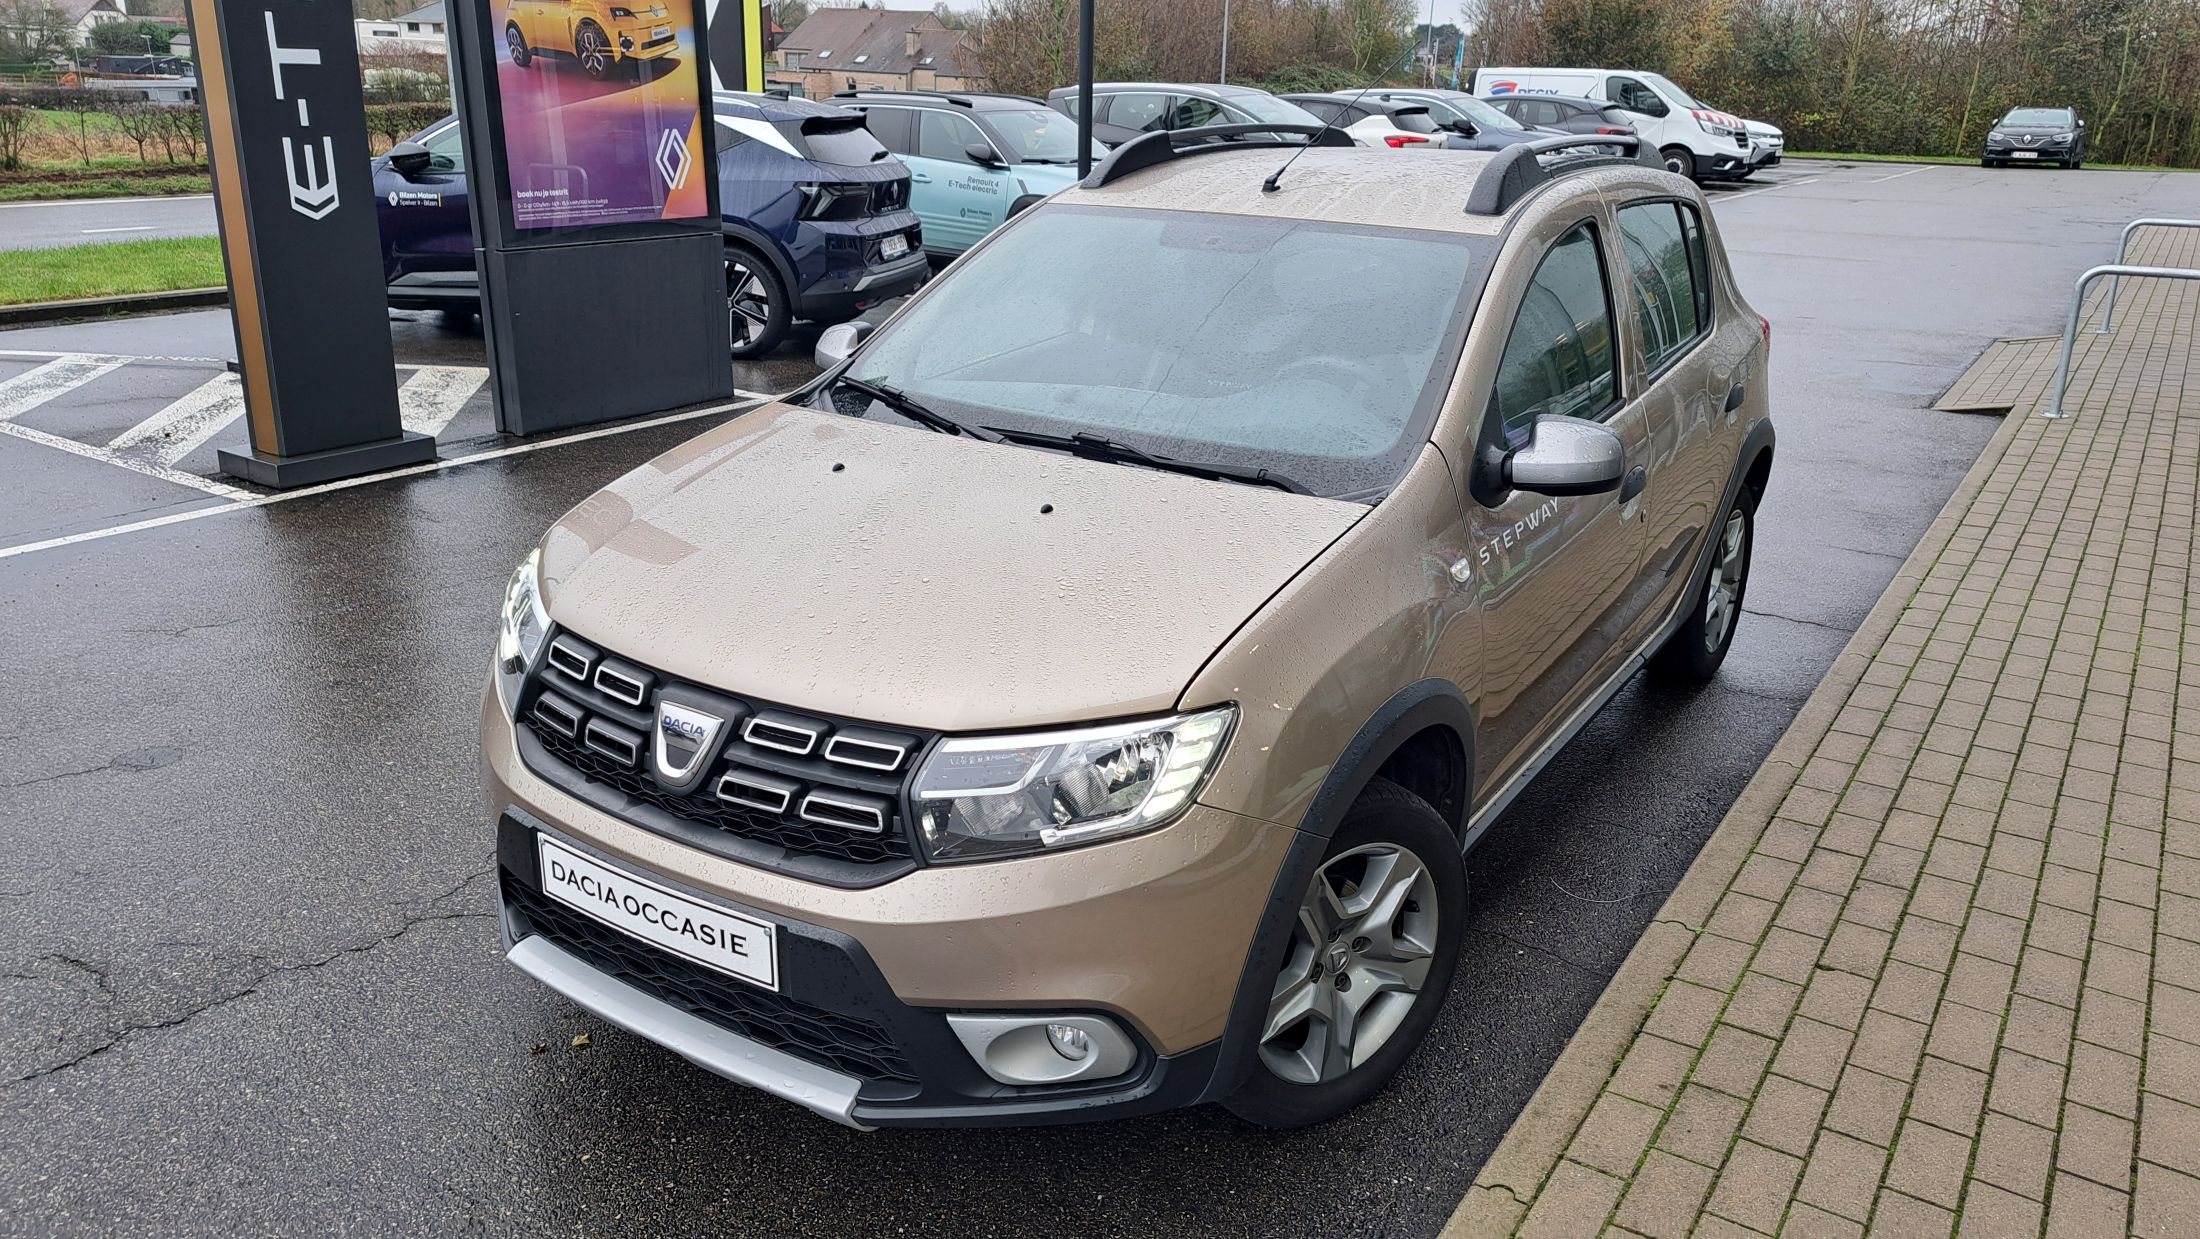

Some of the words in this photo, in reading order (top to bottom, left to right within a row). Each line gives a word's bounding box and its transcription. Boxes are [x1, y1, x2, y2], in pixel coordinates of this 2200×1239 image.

[948, 179, 972, 190] E-Tech
[971, 185, 998, 195] electric
[967, 175, 994, 187] Renault
[417, 191, 438, 199] Motors
[549, 188, 569, 196] testrit
[1479, 496, 1558, 566] STEPWAY
[663, 715, 705, 737] DACIA
[551, 860, 620, 909] DACIA
[623, 894, 749, 958] OCCASIE
